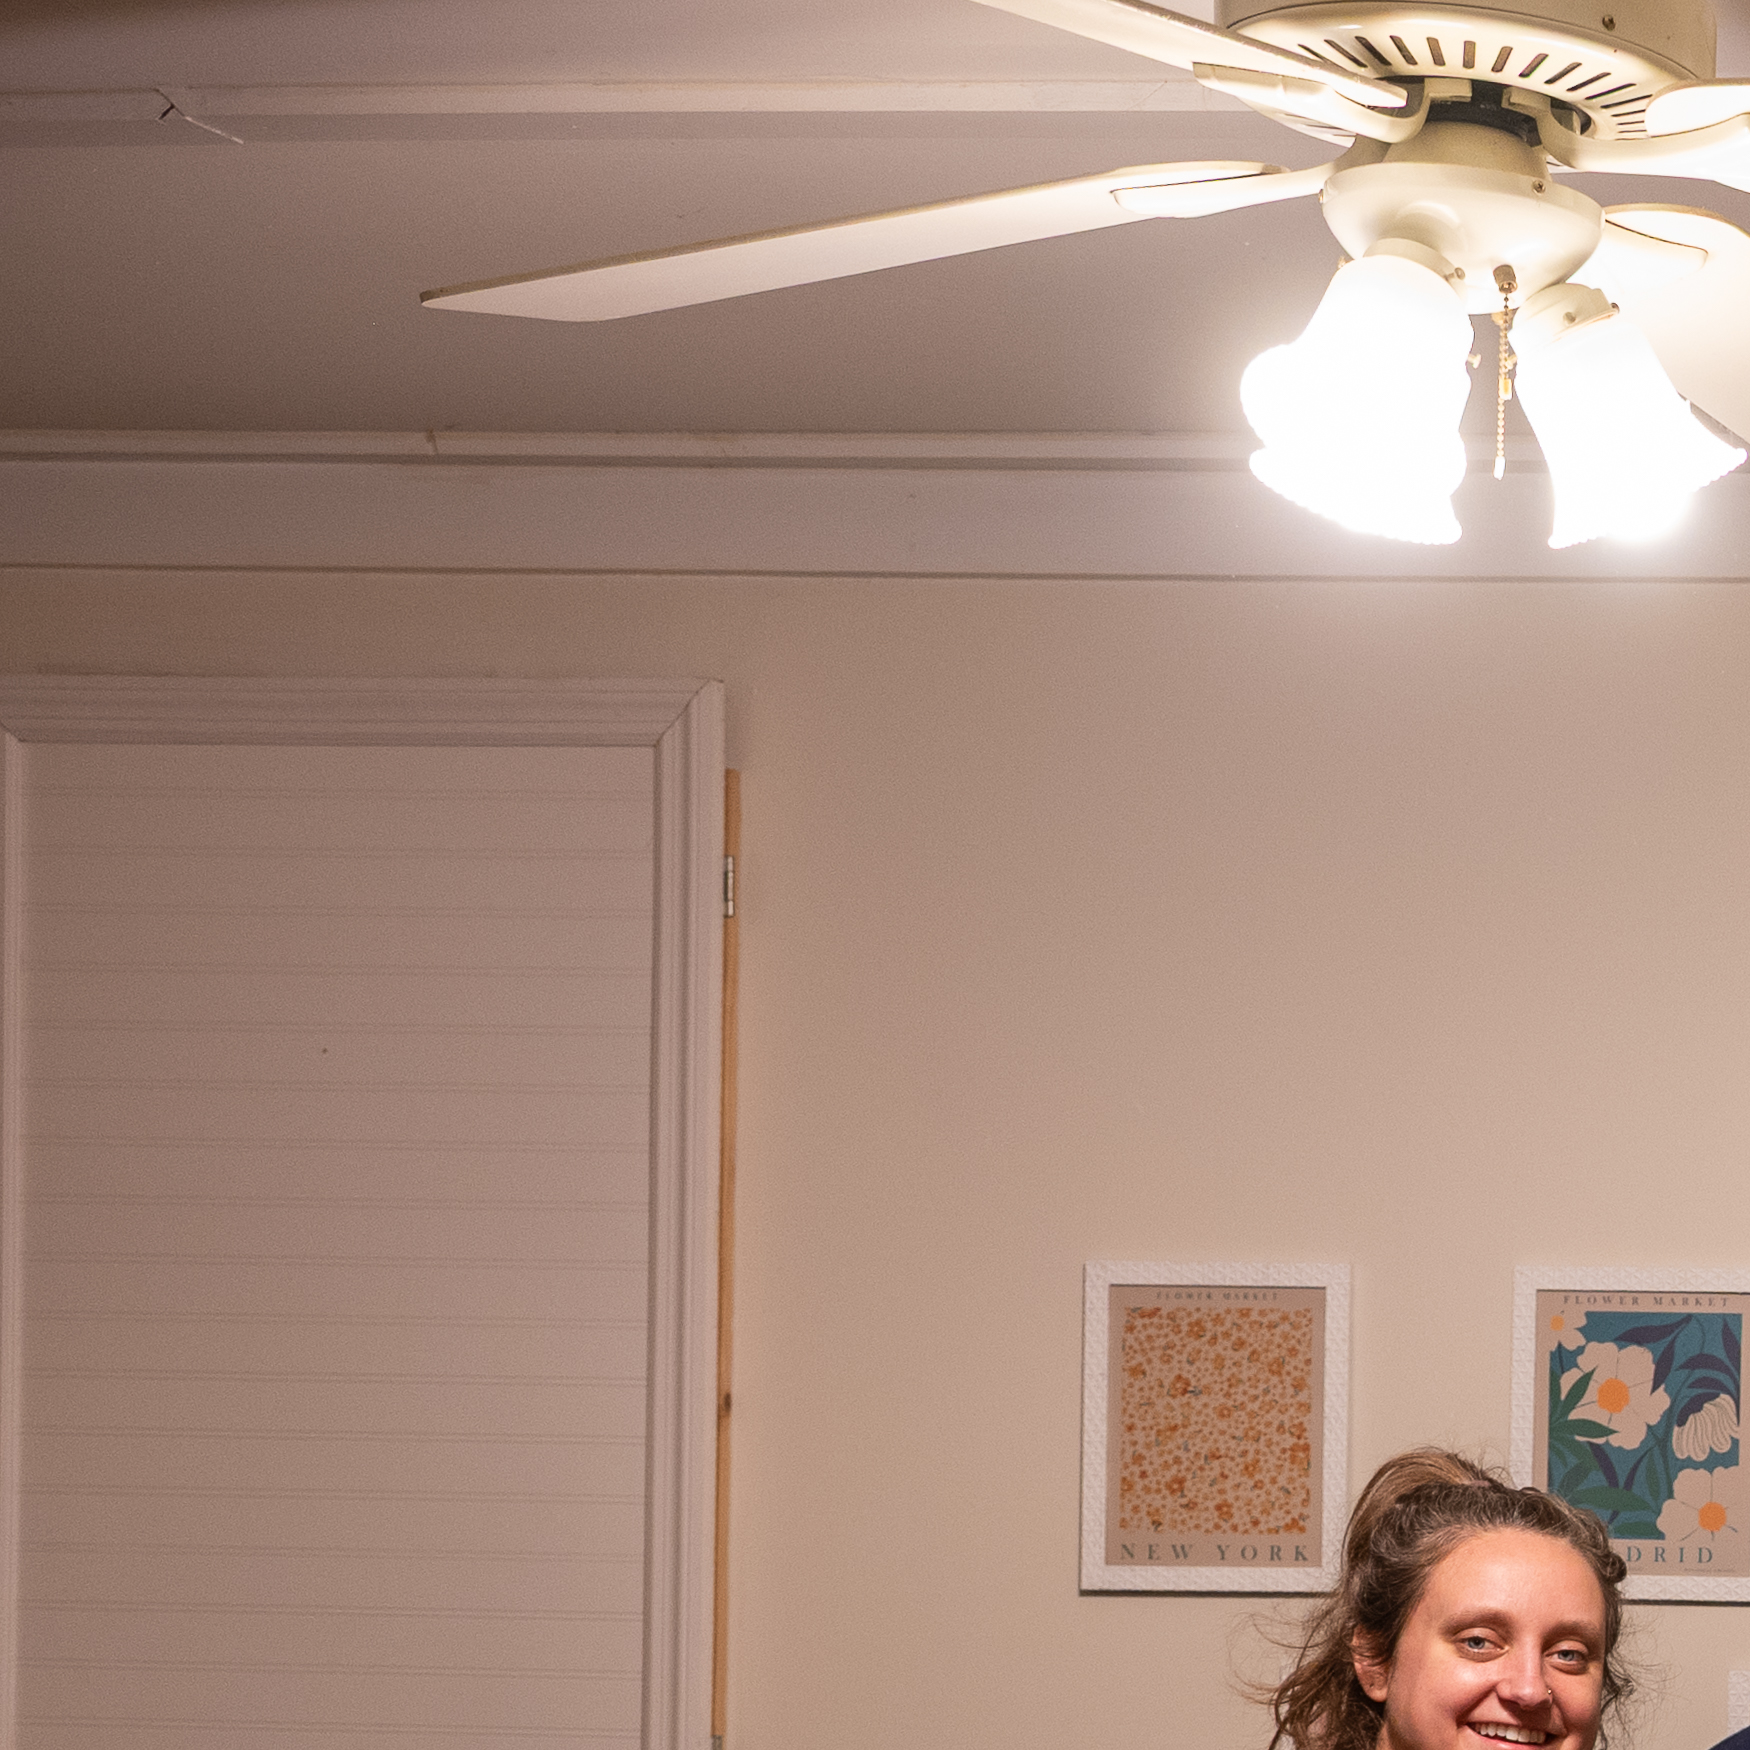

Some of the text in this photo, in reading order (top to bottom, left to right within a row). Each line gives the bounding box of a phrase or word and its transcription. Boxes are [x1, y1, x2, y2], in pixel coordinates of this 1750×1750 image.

[1563, 1295, 1728, 1307] FLOWER MARKET
[1119, 1543, 1309, 1562] NEW YORK
[1626, 1545, 1714, 1564] DRID
